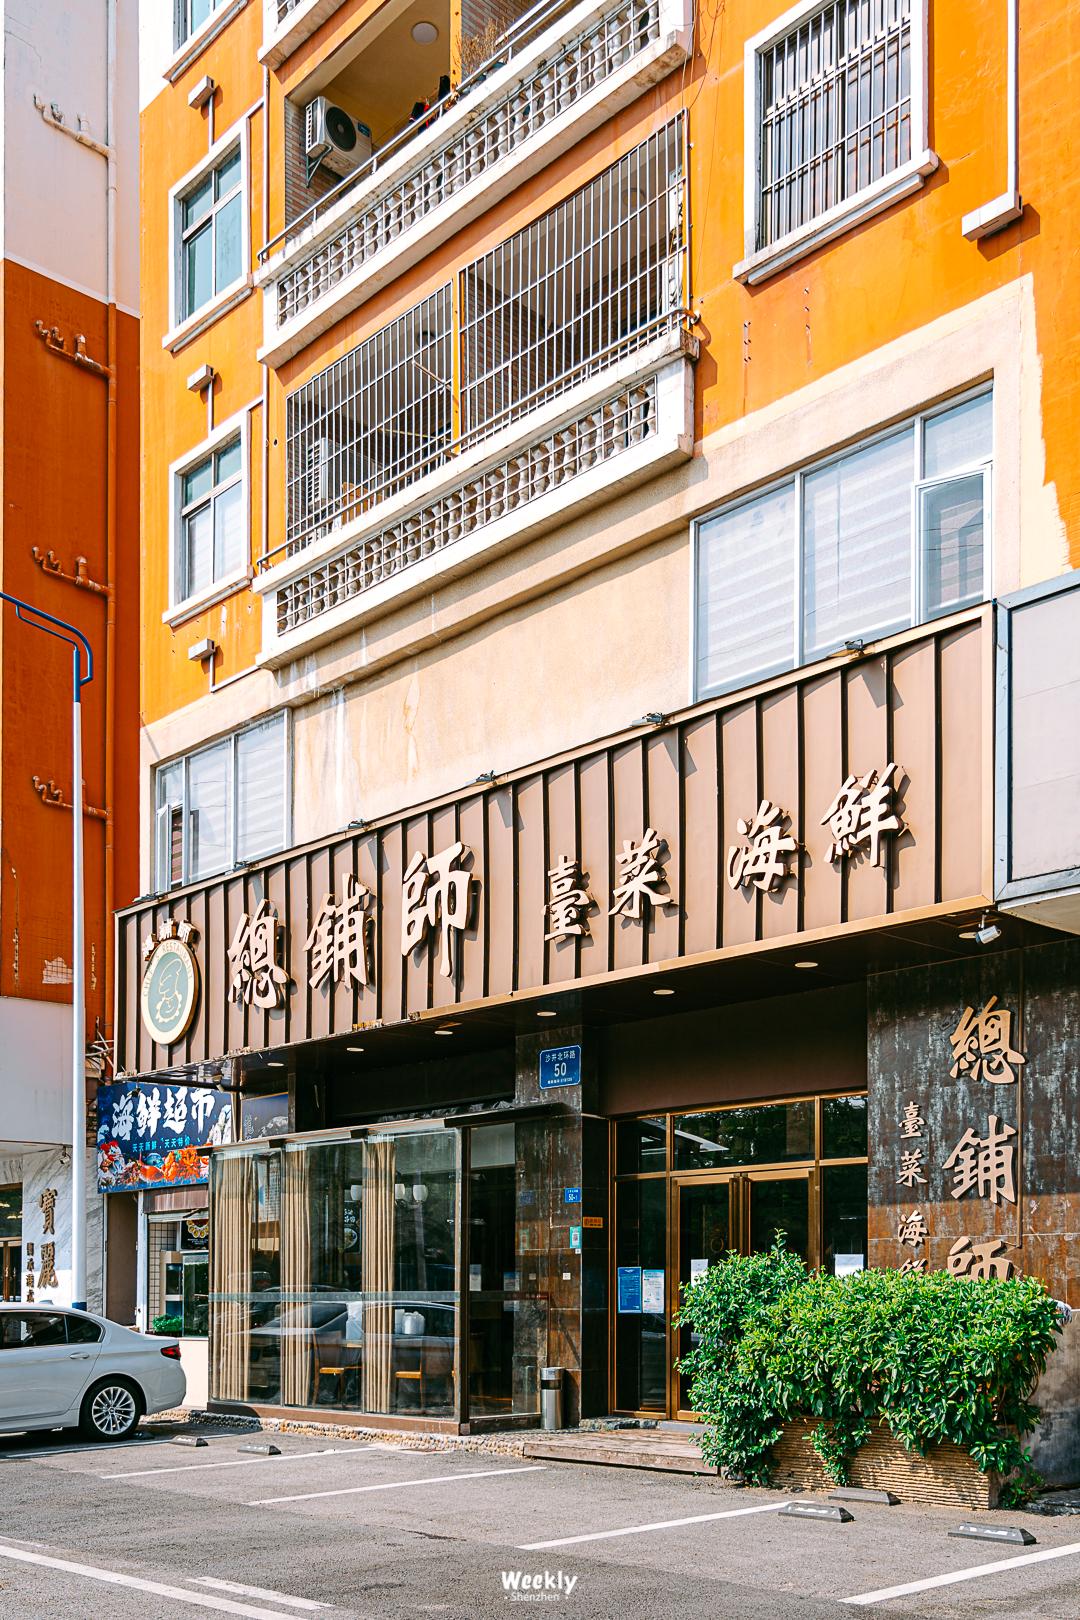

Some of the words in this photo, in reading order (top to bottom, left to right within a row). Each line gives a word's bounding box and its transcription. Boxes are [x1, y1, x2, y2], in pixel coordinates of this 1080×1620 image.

[227, 841, 473, 1009] 總鋪師
[554, 1062, 567, 1077] 50
